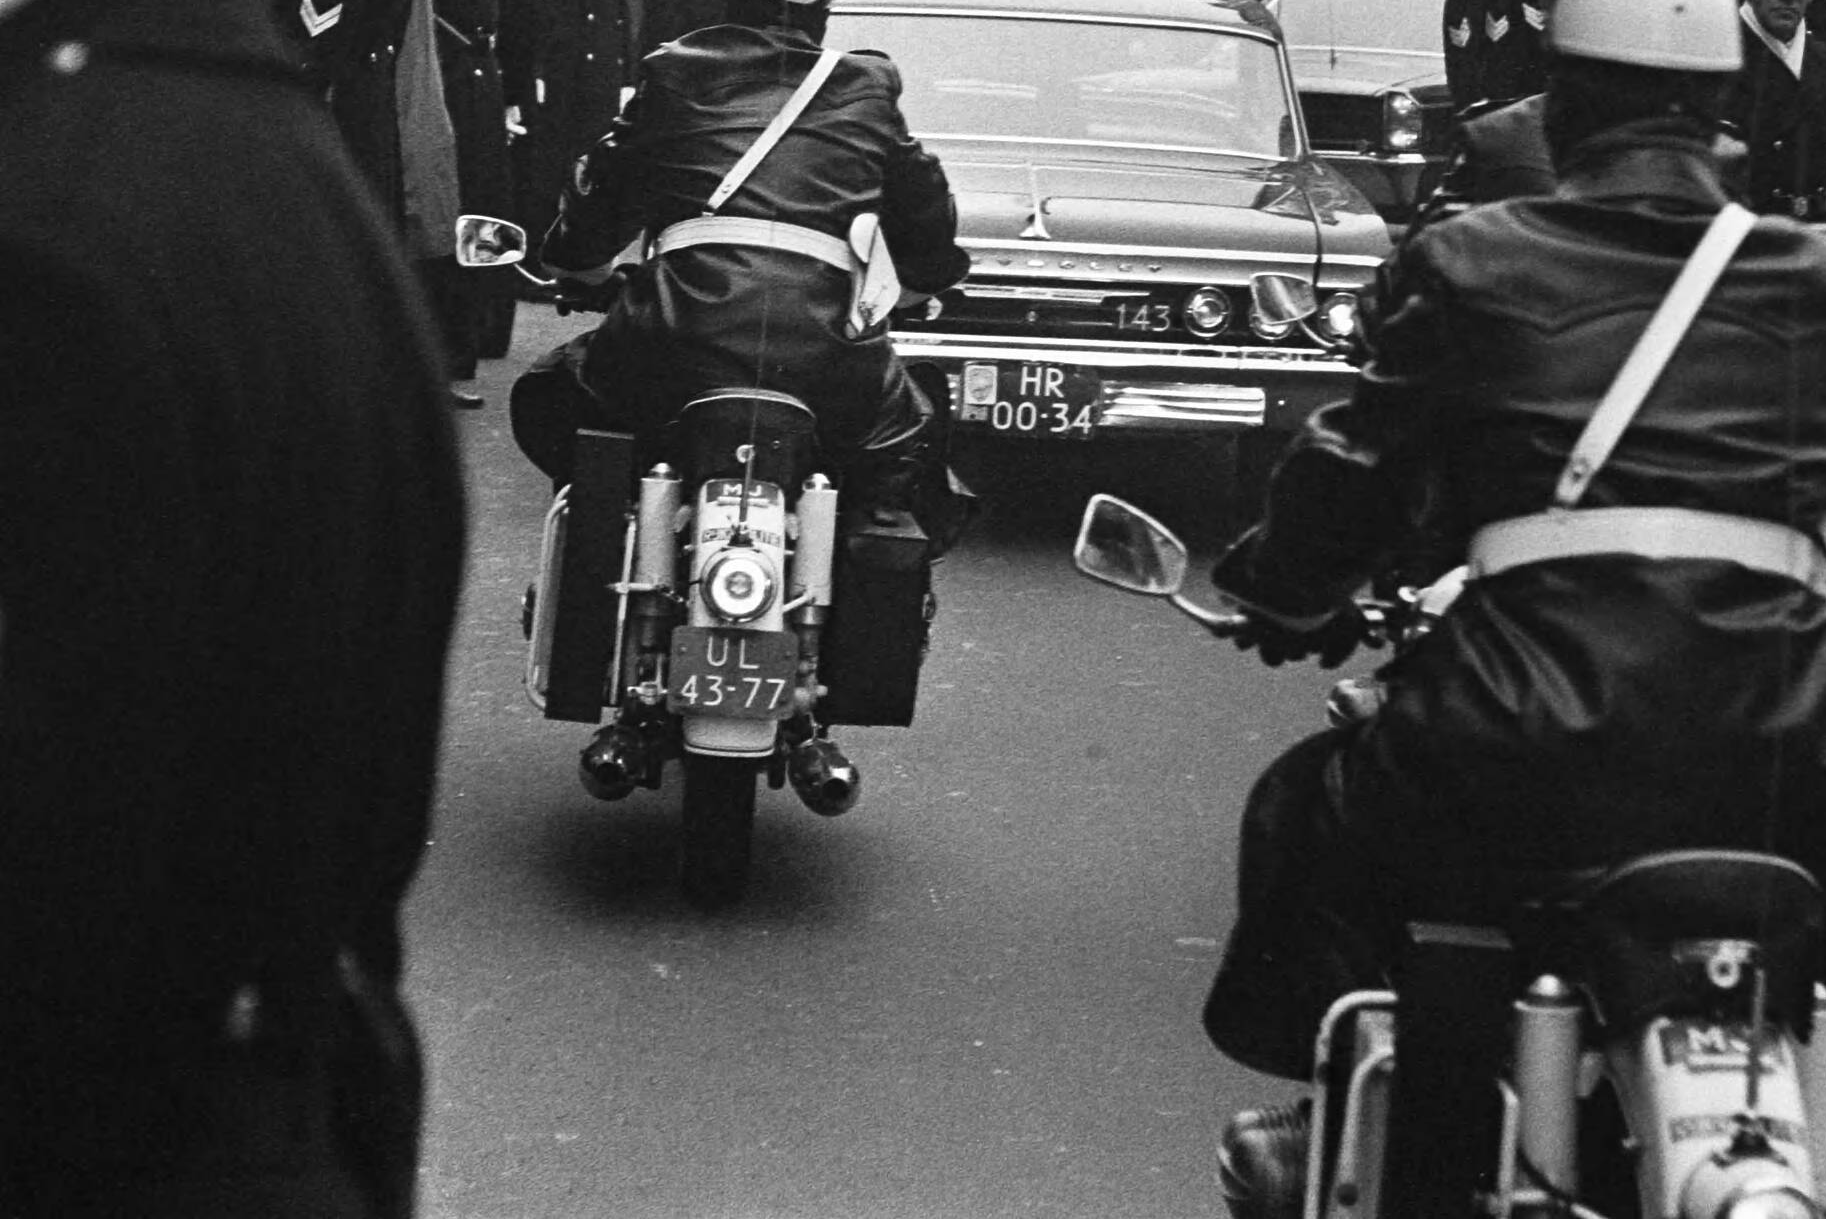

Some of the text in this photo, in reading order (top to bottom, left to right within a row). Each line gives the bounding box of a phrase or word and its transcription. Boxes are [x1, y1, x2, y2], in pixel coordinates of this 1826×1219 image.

[1116, 303, 1171, 332] 143
[1020, 366, 1065, 398] HR
[992, 401, 1093, 435] 00-34
[706, 636, 759, 669] UL
[680, 675, 786, 710] 43-77
